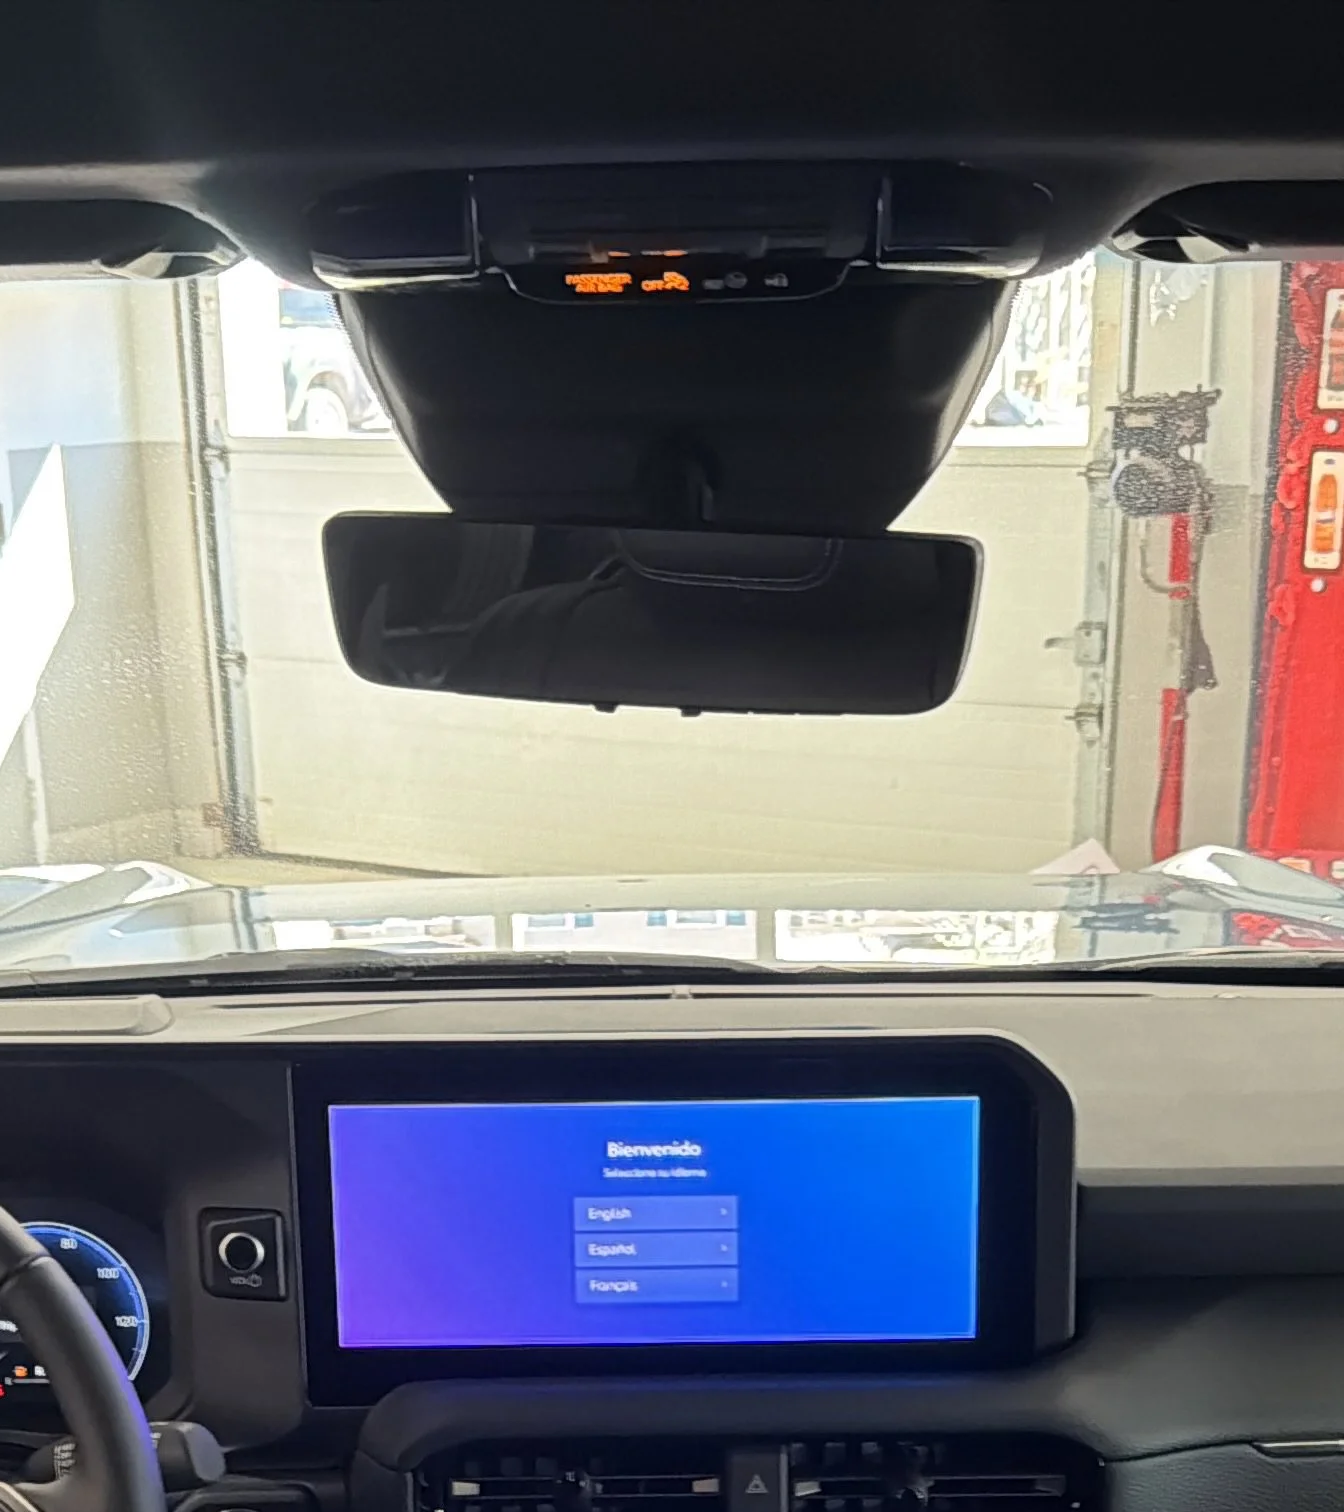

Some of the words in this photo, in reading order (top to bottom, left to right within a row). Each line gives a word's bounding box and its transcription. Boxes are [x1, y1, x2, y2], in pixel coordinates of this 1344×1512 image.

[607, 1140, 701, 1158] Bienvenido
[587, 1207, 632, 1221] English
[587, 1243, 637, 1256] Español
[589, 1279, 638, 1292] Français
